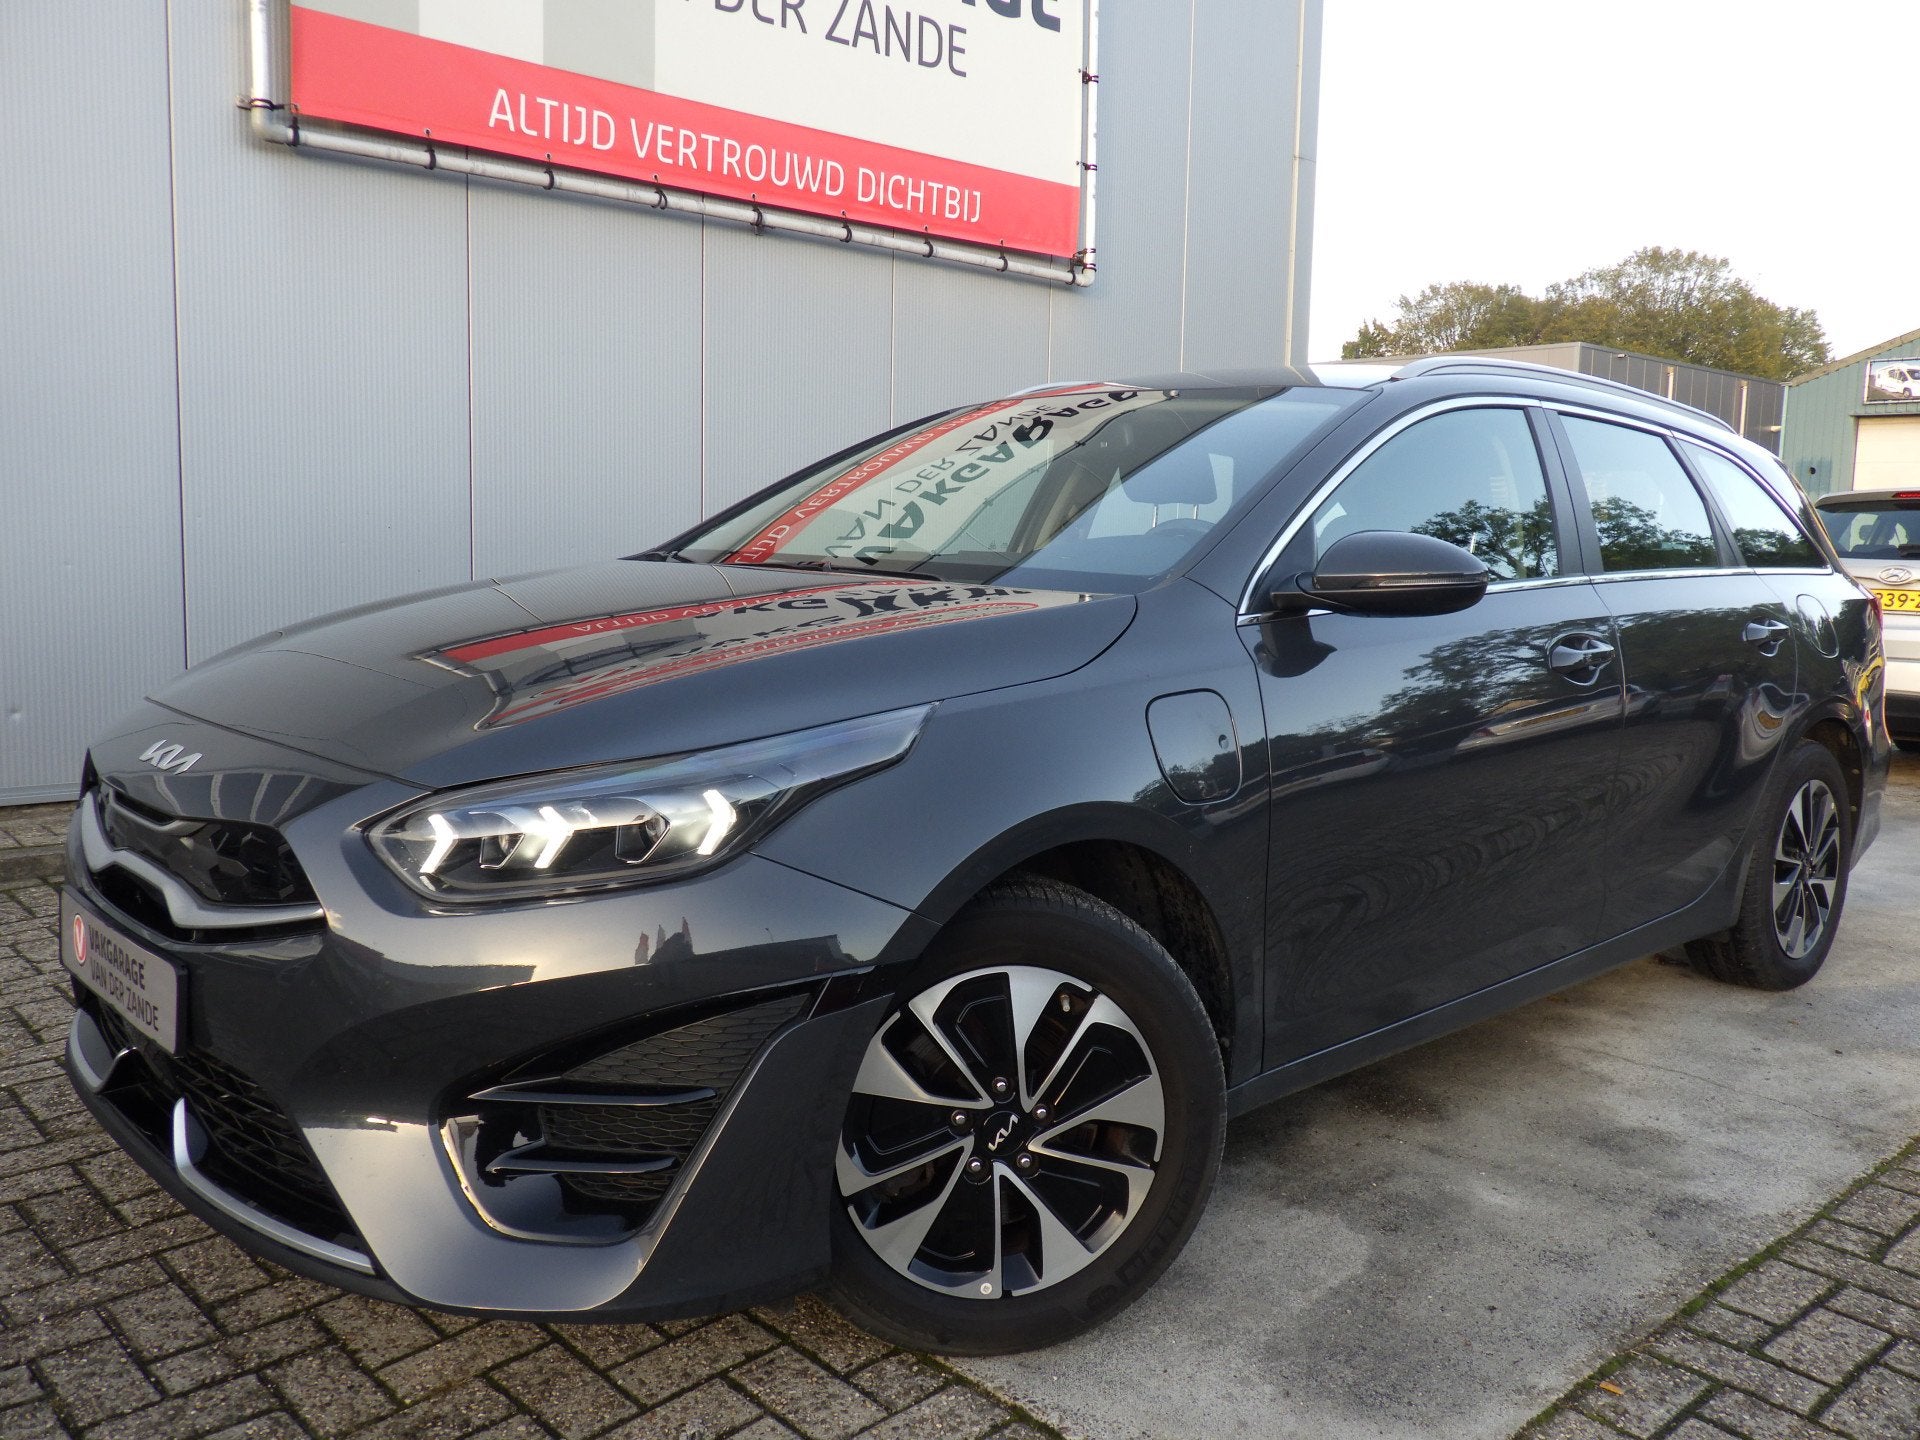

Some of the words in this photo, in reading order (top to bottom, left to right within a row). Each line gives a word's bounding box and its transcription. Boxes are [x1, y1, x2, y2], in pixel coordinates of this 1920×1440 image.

[825, 0, 968, 78] ZANDE
[488, 88, 615, 152] ALTIJD
[630, 117, 844, 197] VERTROUWD
[857, 168, 982, 224] DICHTBIJ
[139, 739, 203, 775] KIA
[88, 924, 146, 991] VAKGARAGE
[90, 956, 107, 991] VAN
[108, 970, 125, 1005] DER
[126, 986, 159, 1032] ZANDE
